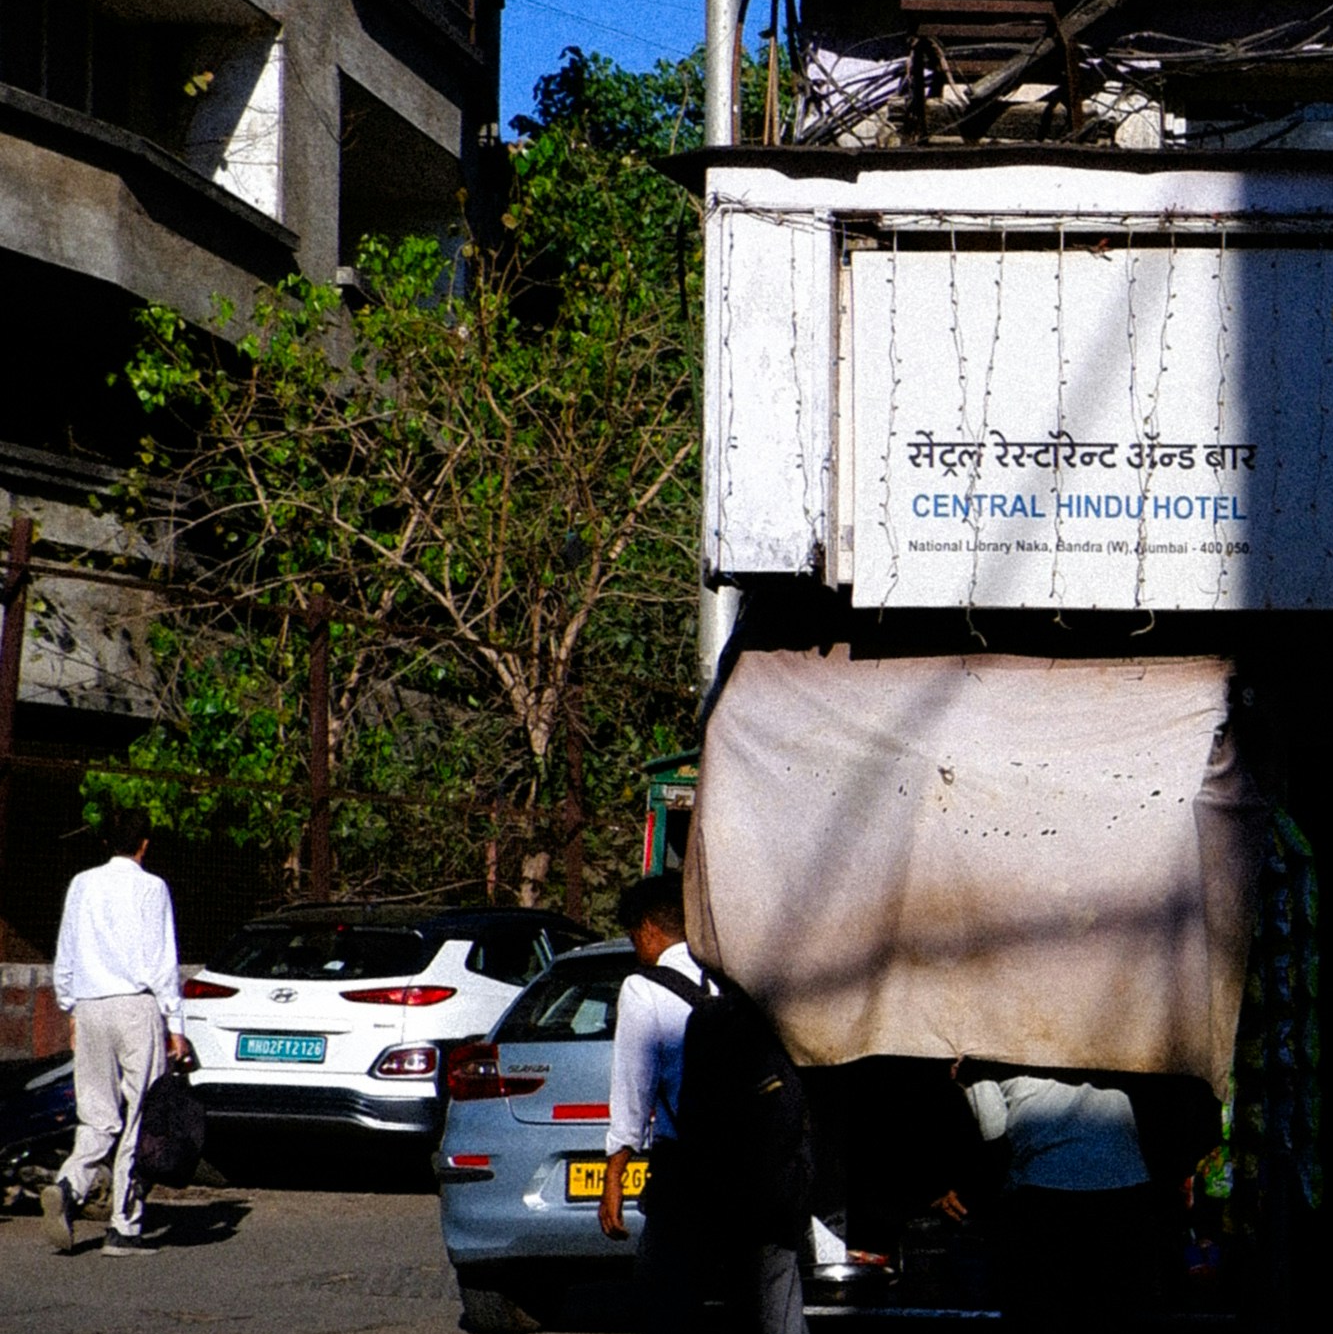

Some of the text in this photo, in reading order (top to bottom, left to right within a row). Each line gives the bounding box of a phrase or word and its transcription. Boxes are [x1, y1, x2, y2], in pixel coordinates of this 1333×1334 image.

[1203, 444, 1257, 470] बार
[912, 493, 1248, 520] CENTRAL HINDU HOTEL
[908, 539, 962, 553] National
[966, 539, 1012, 555] Library
[1016, 540, 1052, 554] Naka,
[1056, 539, 1103, 554] Bandra
[1200, 541, 1223, 554] 400
